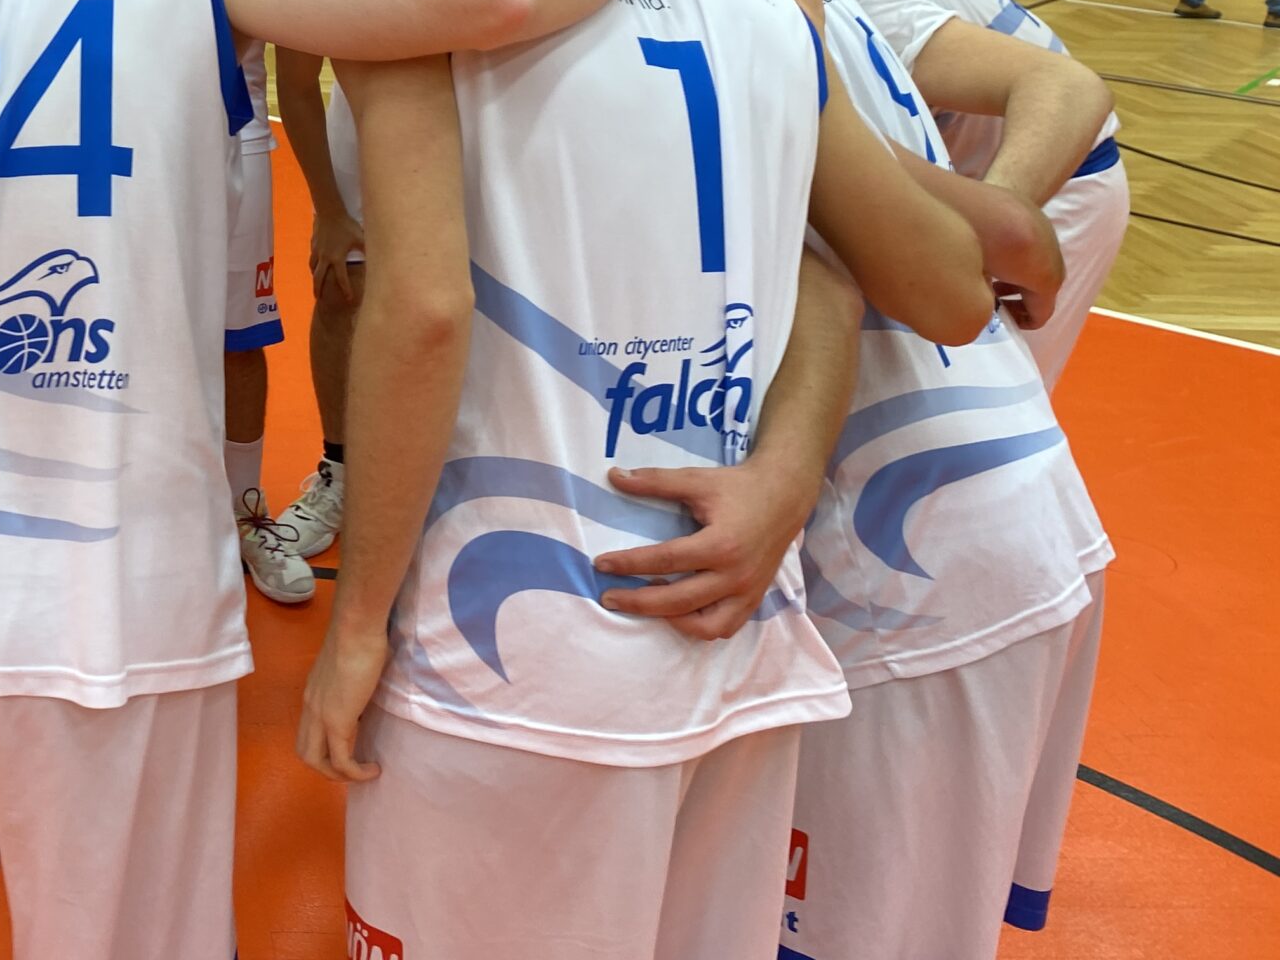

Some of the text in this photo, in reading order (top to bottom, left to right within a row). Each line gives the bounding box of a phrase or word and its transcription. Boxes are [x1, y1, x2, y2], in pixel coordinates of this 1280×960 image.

[637, 37, 726, 272] 1
[578, 336, 694, 360] union citycenter
